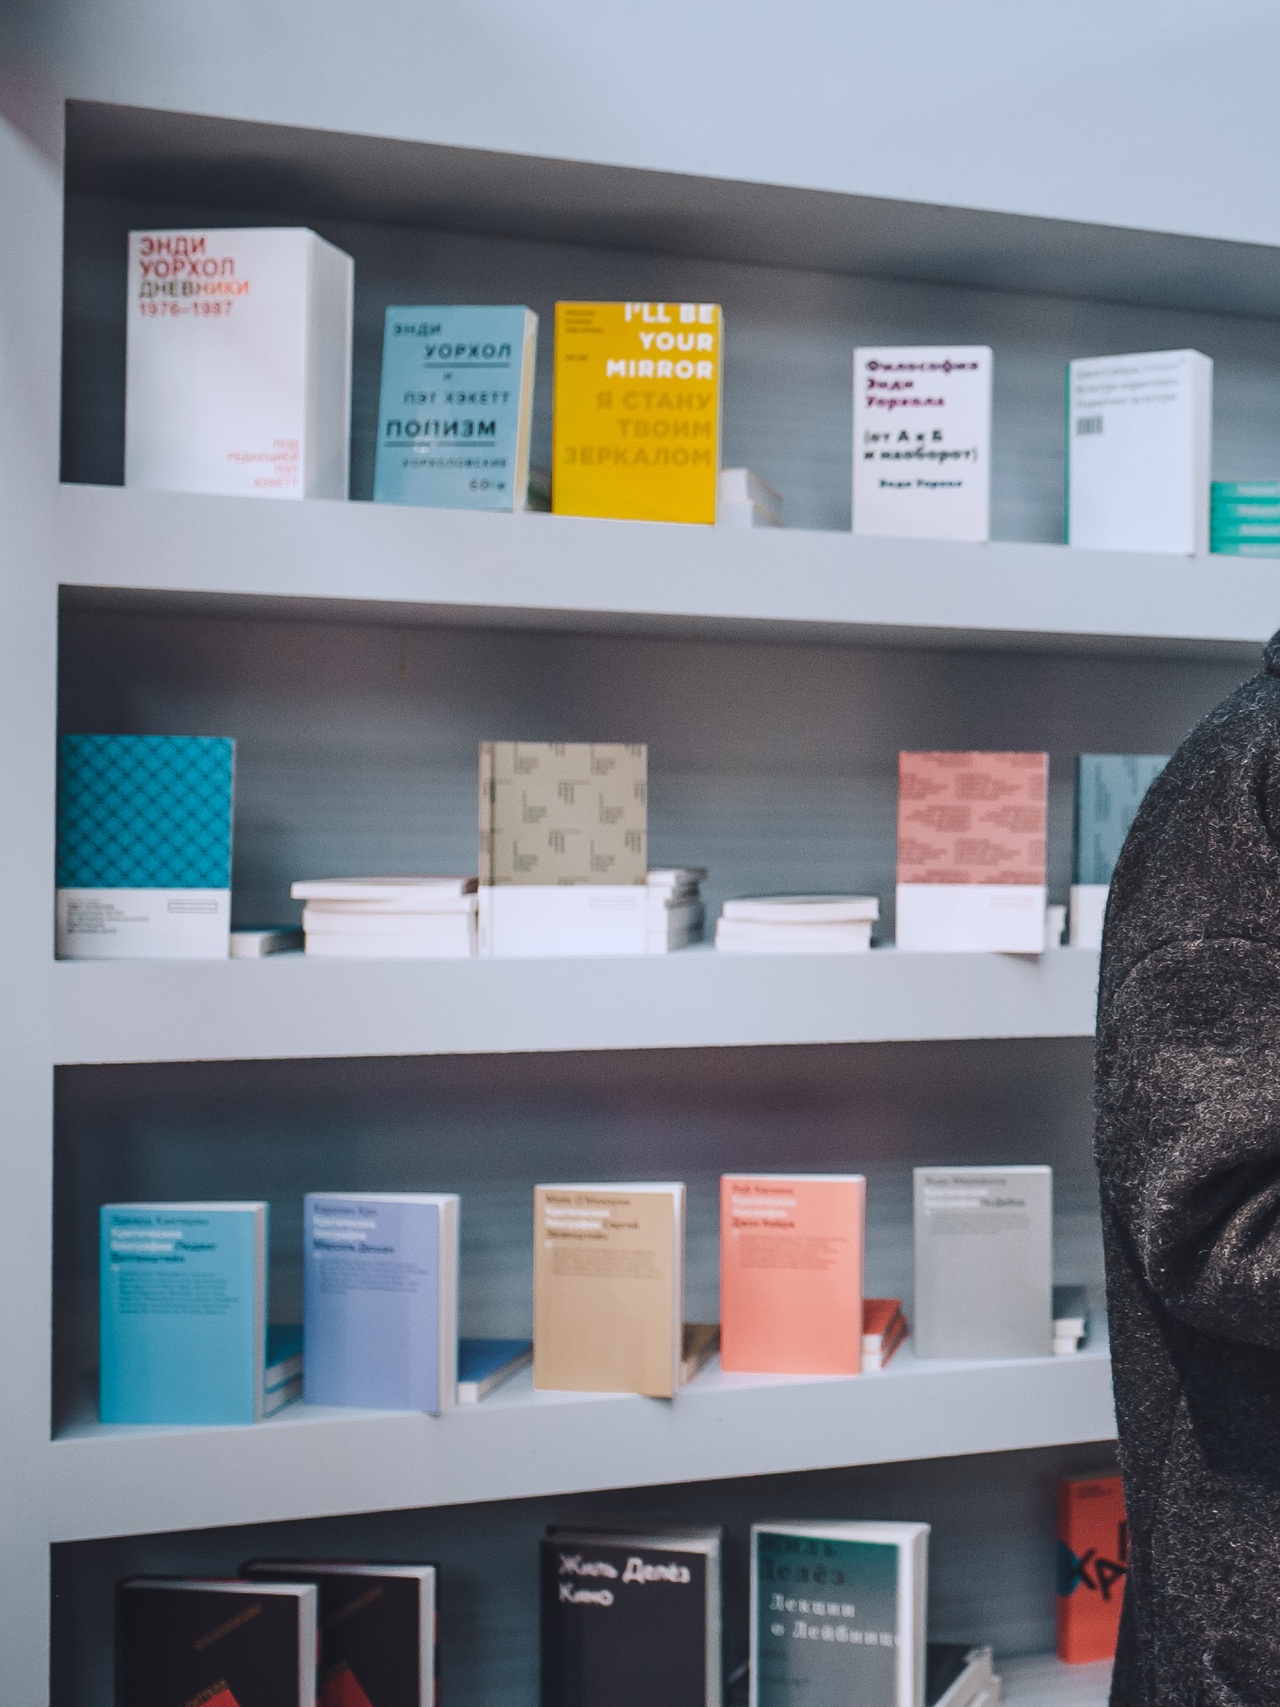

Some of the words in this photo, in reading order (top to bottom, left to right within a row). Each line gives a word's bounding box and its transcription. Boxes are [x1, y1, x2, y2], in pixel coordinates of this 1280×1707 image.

[140, 237, 206, 255] ЭНДИ
[140, 257, 235, 277] УОРХОЛ
[138, 280, 250, 299] ДНЕВНИКИ
[680, 304, 714, 324] BE
[393, 322, 441, 337] ЭНДИ
[424, 343, 512, 359] УОРХОЛ
[639, 332, 713, 352] YOUR
[606, 360, 713, 379] MIRROR
[403, 391, 436, 405] ПЭТ
[596, 392, 613, 410] Я
[623, 391, 713, 411] СТАНУ
[386, 419, 496, 438] ПОПИЗМ
[617, 419, 712, 439] ТВОИМ
[564, 447, 712, 466] ЗЕРКАЛОМ
